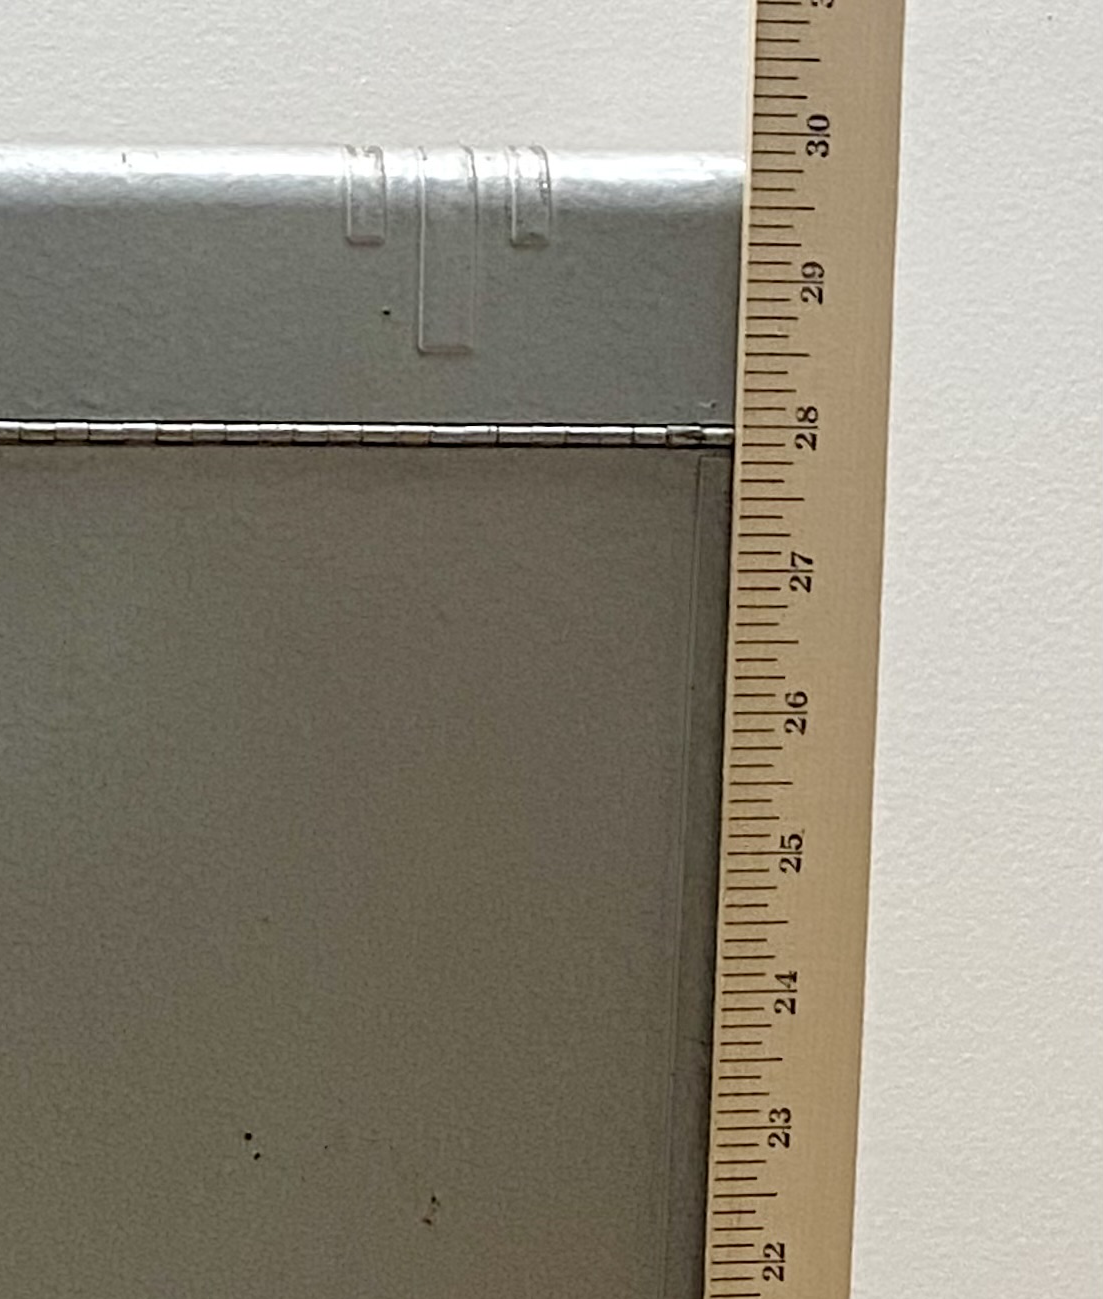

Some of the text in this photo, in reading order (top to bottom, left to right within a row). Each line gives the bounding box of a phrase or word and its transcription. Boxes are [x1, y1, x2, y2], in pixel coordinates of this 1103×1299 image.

[806, 114, 831, 159] 30
[801, 262, 826, 305] 29
[795, 405, 819, 451] 28
[789, 551, 814, 593] 27
[784, 691, 809, 735] 26
[779, 833, 804, 873] 25
[774, 971, 798, 1015] 24
[768, 1108, 792, 1149] 23
[762, 1242, 786, 1282] 22
